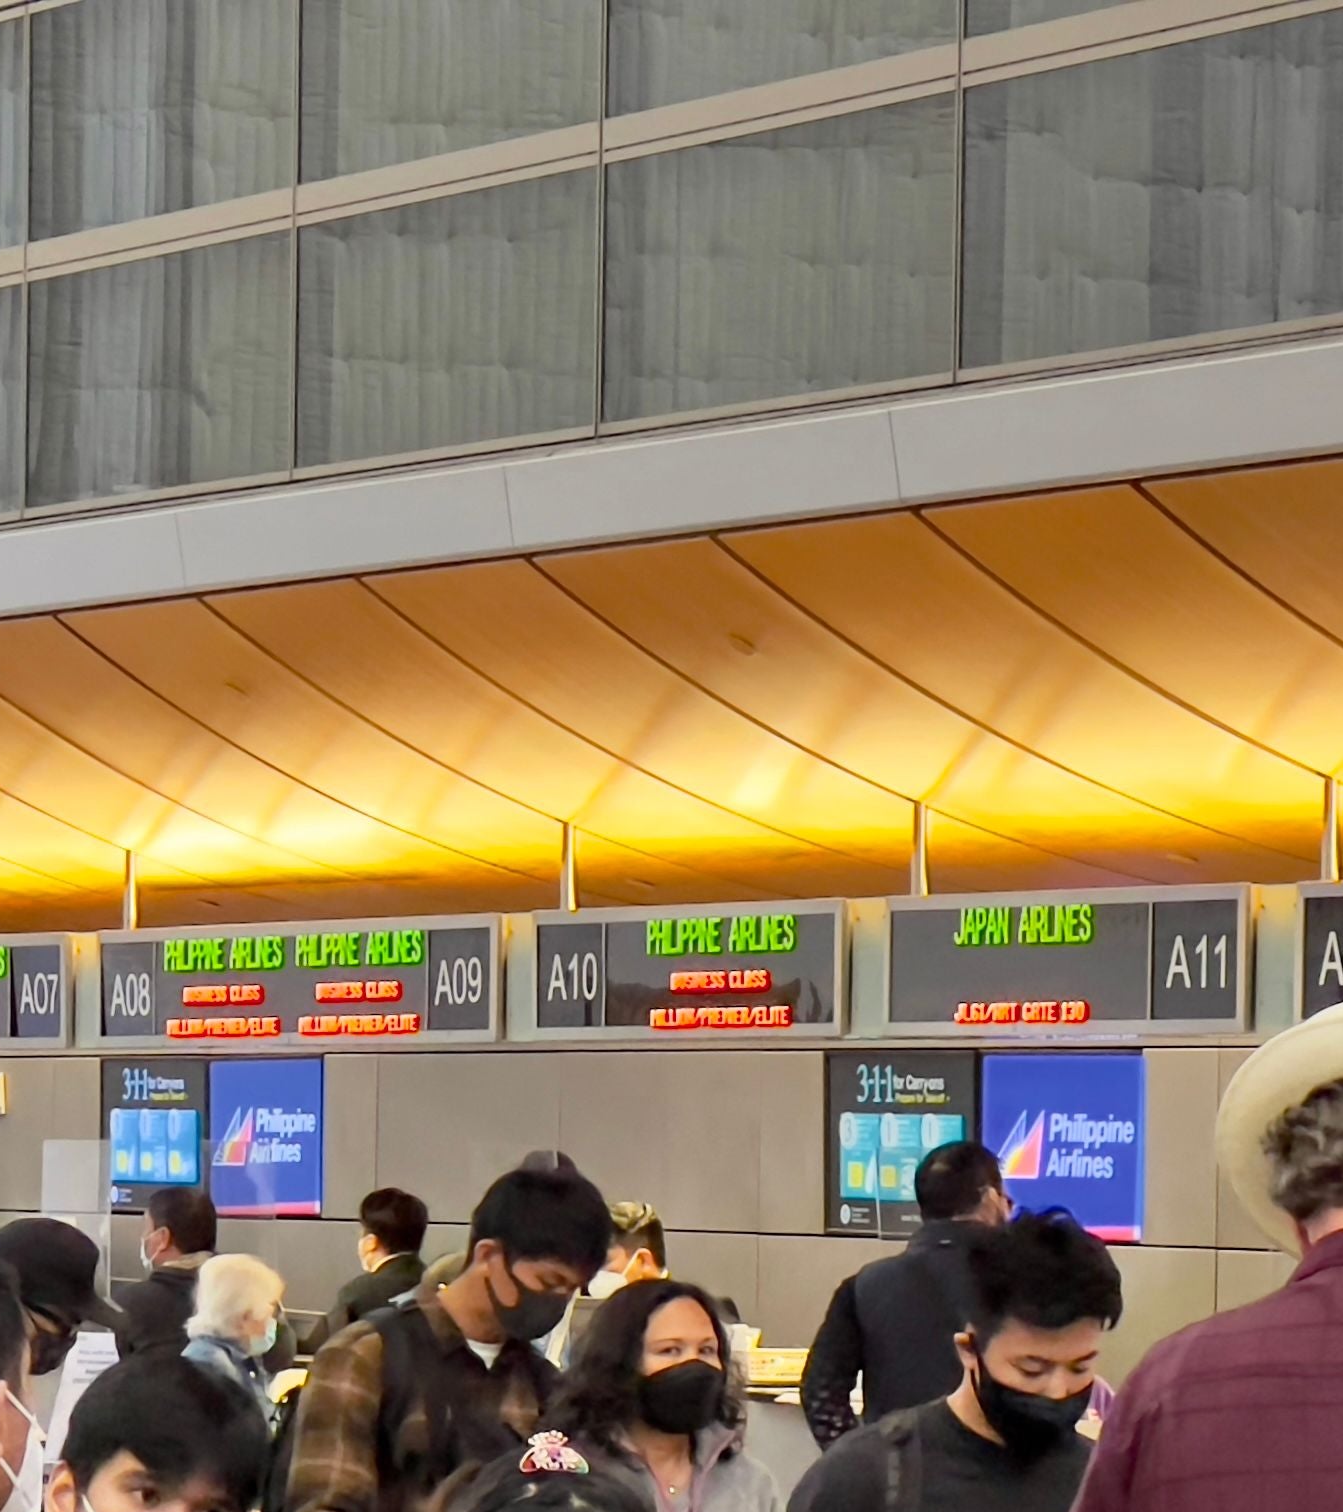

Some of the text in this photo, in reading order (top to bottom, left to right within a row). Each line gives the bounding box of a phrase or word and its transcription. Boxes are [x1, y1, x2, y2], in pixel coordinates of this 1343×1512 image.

[954, 903, 1091, 945] JAPAN AIRLINES
[434, 957, 482, 1006] A09
[547, 953, 598, 1001] A10
[1165, 935, 1228, 989] A11
[20, 973, 59, 1014] A07
[111, 973, 150, 1017] A08
[256, 1107, 317, 1138] Philippine
[1048, 1112, 1136, 1149] Philippine
[1045, 1148, 1114, 1180] Airlines
